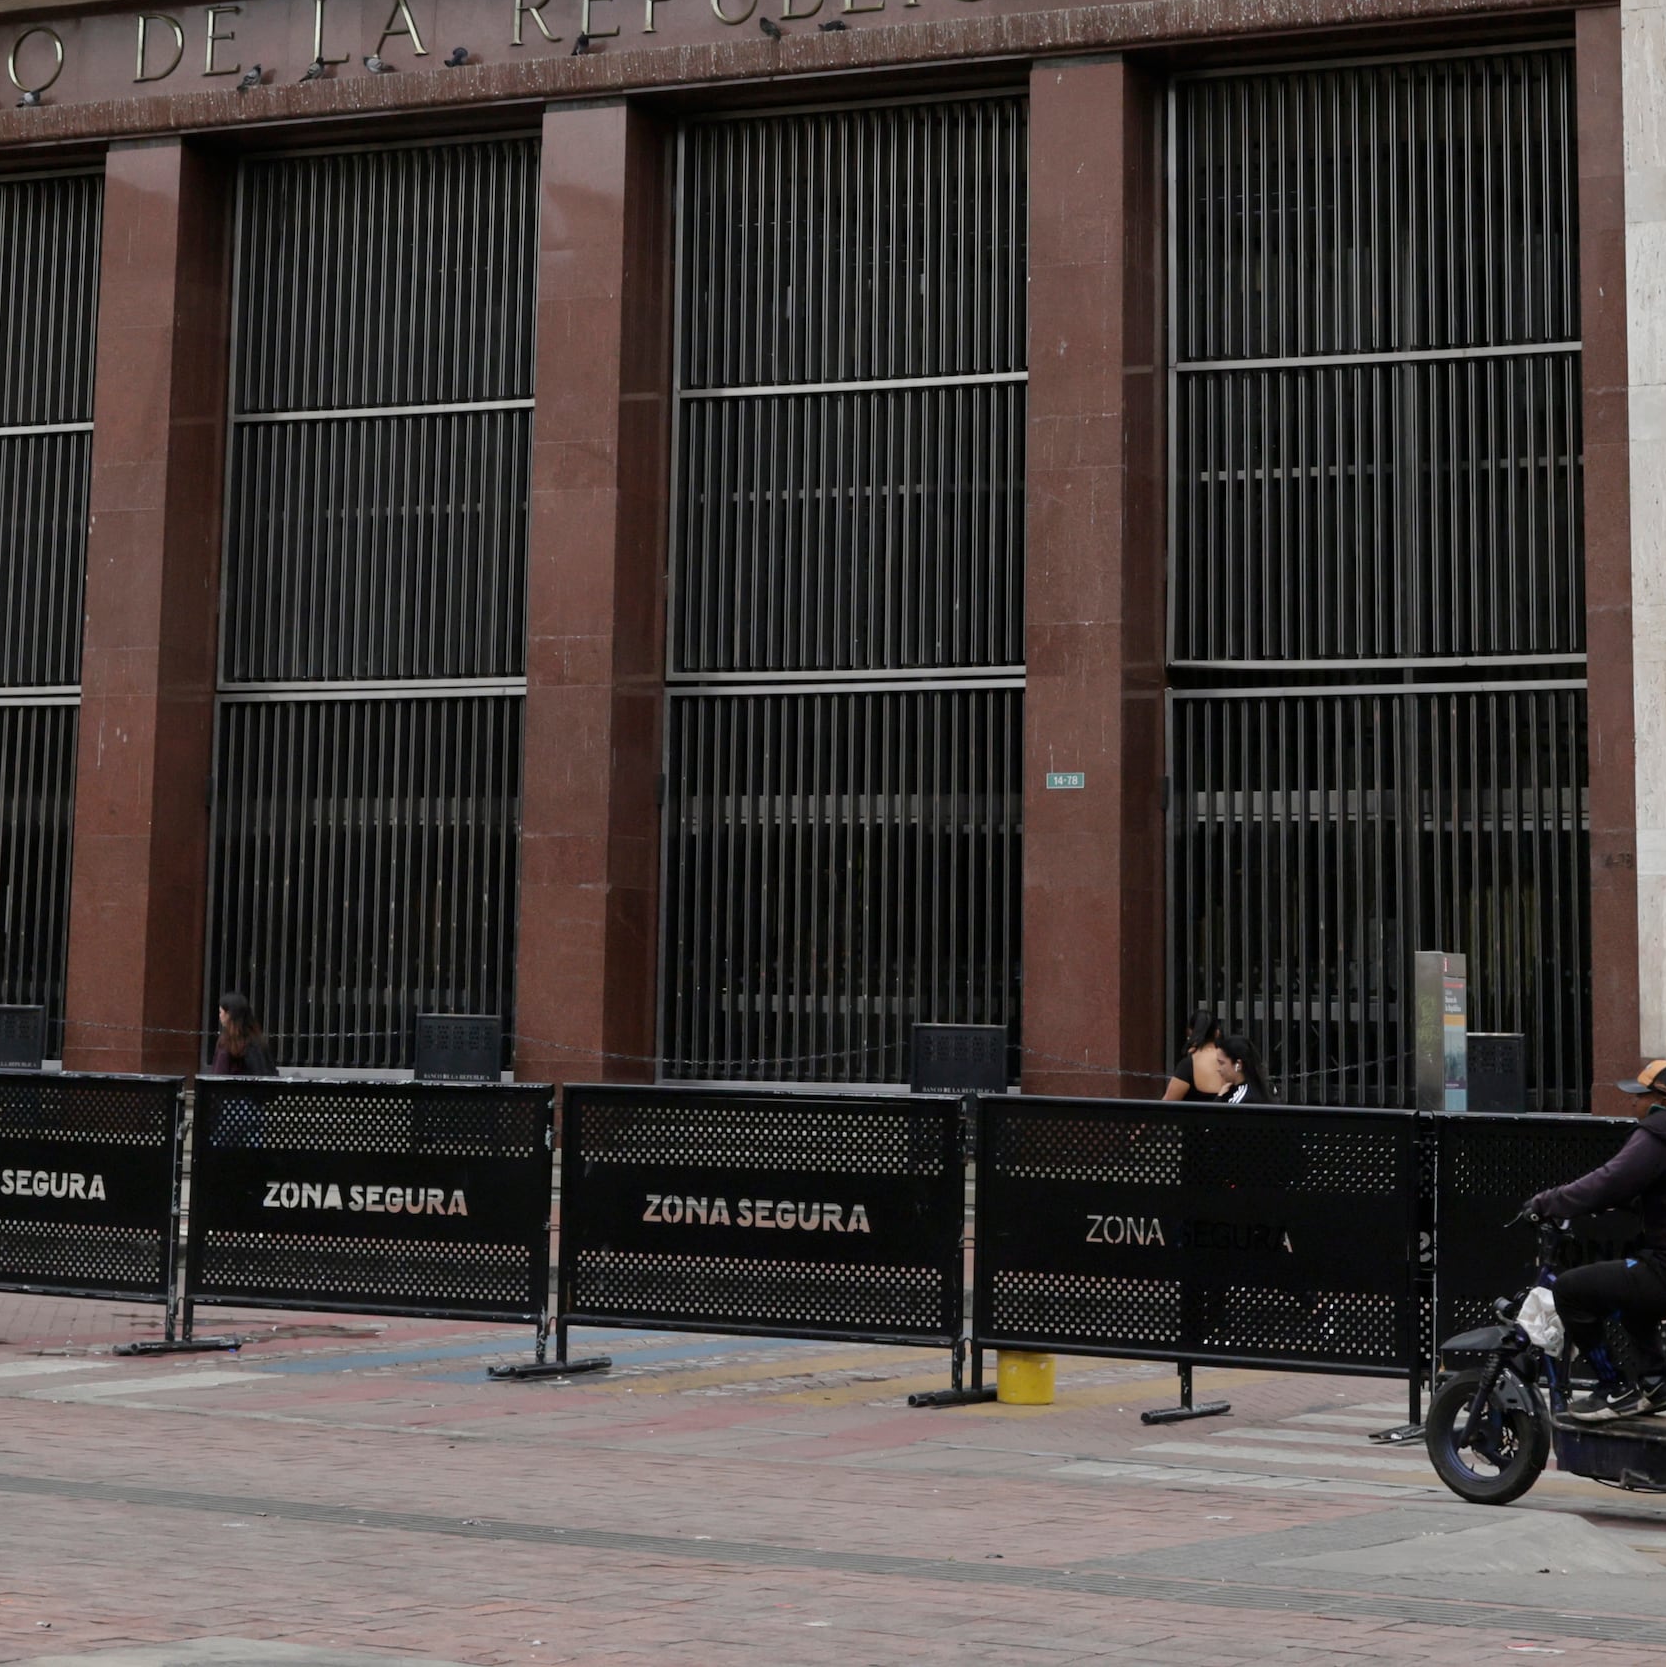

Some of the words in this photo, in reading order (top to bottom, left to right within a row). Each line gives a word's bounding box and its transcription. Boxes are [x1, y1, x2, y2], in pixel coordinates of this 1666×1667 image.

[132, 5, 242, 83] DE
[1052, 775, 1079, 786] 14-78
[0, 1169, 106, 1201] SEGURA
[263, 1182, 343, 1210] ZONA
[348, 1185, 468, 1216] SEGURA
[643, 1194, 731, 1226] ZONA
[737, 1198, 871, 1233] SEGURA
[1086, 1214, 1165, 1246] ZONA
